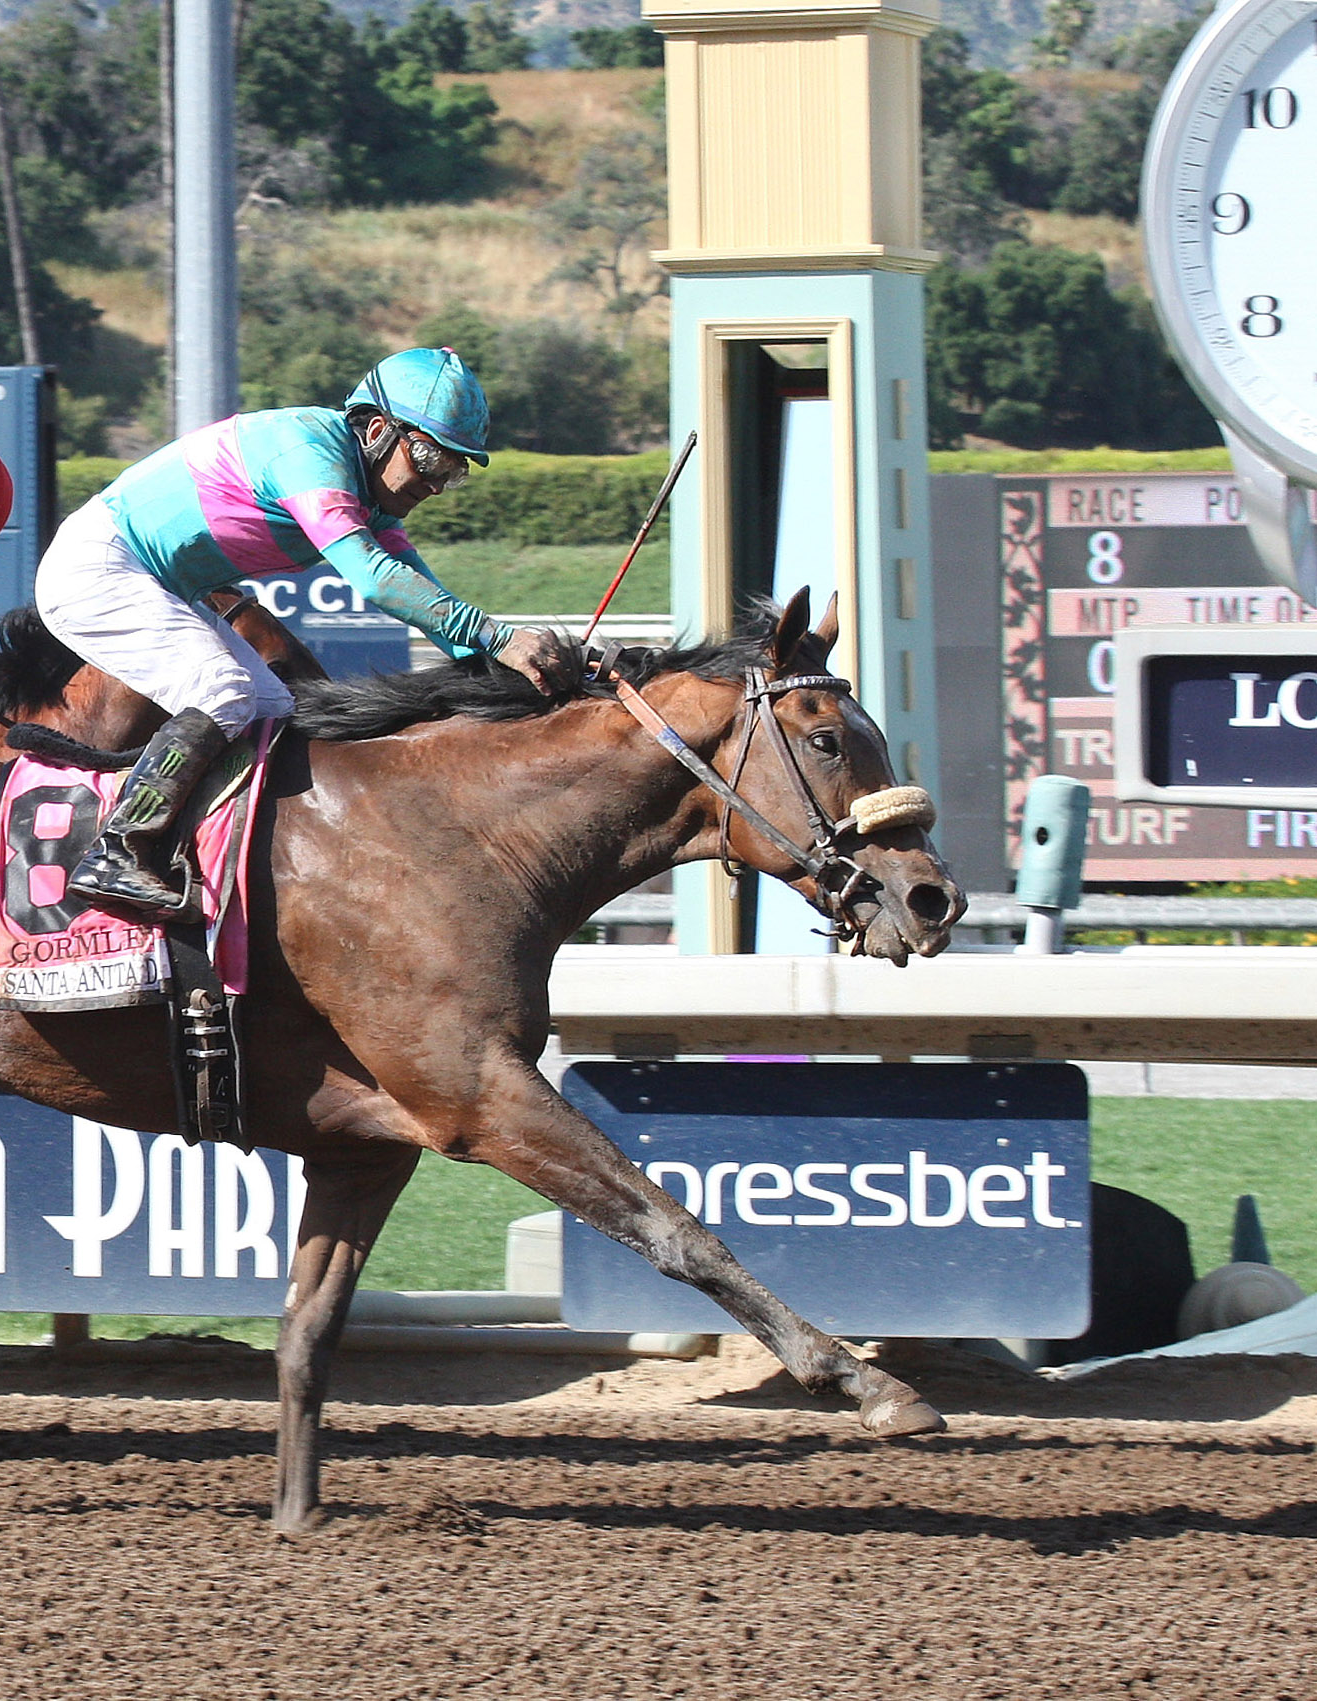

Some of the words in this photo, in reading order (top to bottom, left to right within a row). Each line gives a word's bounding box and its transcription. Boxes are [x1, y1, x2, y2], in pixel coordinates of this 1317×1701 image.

[1240, 86, 1298, 129] 10
[1211, 192, 1251, 236] 9
[1240, 294, 1283, 338] 8
[1067, 487, 1144, 522] RACE
[1087, 530, 1124, 585] 8
[1077, 597, 1139, 632] MTP
[1085, 808, 1191, 845] TURF
[5, 783, 103, 935] 8
[11, 926, 154, 965] GORMLE
[5, 971, 67, 996] SANTA
[77, 962, 141, 993] ANITA
[576, 1150, 1067, 1228] pressbet
